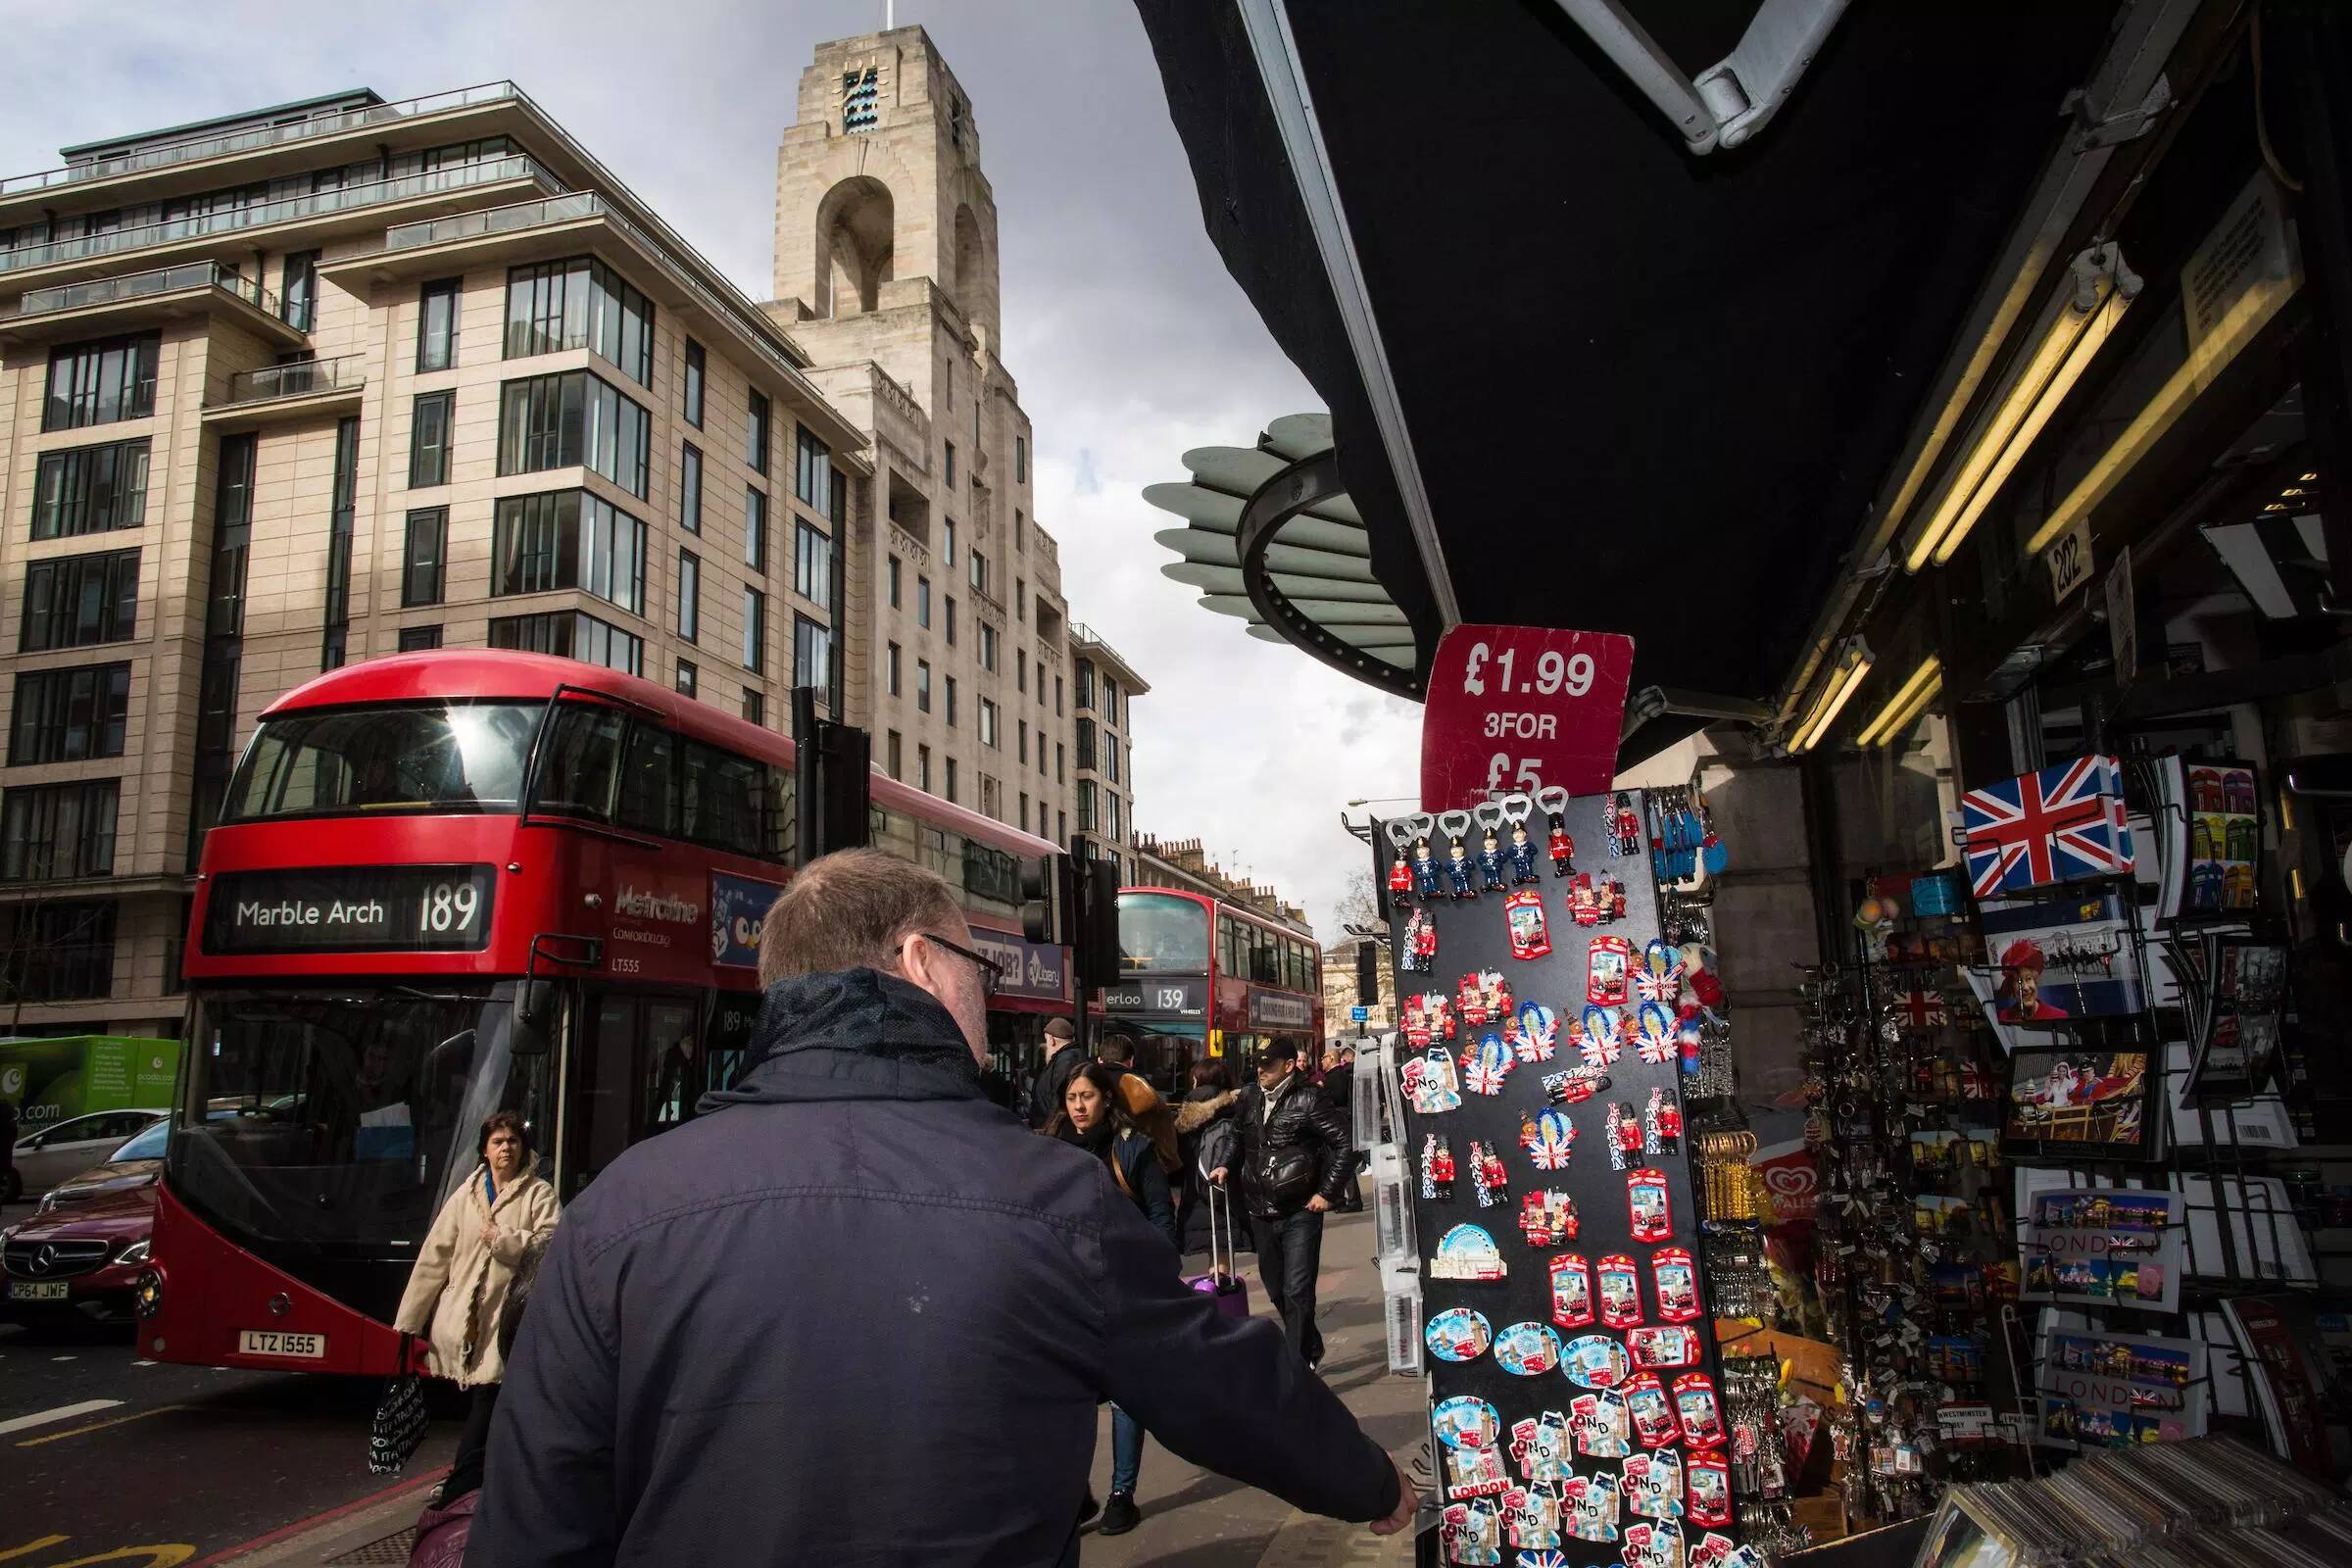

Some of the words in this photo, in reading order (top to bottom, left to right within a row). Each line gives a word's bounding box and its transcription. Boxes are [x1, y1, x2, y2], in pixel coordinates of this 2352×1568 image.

[1464, 642, 1595, 697] £1.99
[1484, 712, 1557, 739] 3FOR
[1487, 753, 1543, 800] £5
[237, 900, 319, 926] Marble
[326, 899, 383, 924] Arch
[420, 882, 477, 931] 189
[612, 957, 640, 973] LT555
[1156, 989, 1184, 1008] 139
[723, 1010, 741, 1032] 189
[13, 1283, 38, 1298] CP64
[42, 1283, 67, 1298] JWF
[249, 1334, 278, 1351] LTZ
[281, 1335, 316, 1353] 1555
[1452, 1480, 1510, 1498] LONDON
